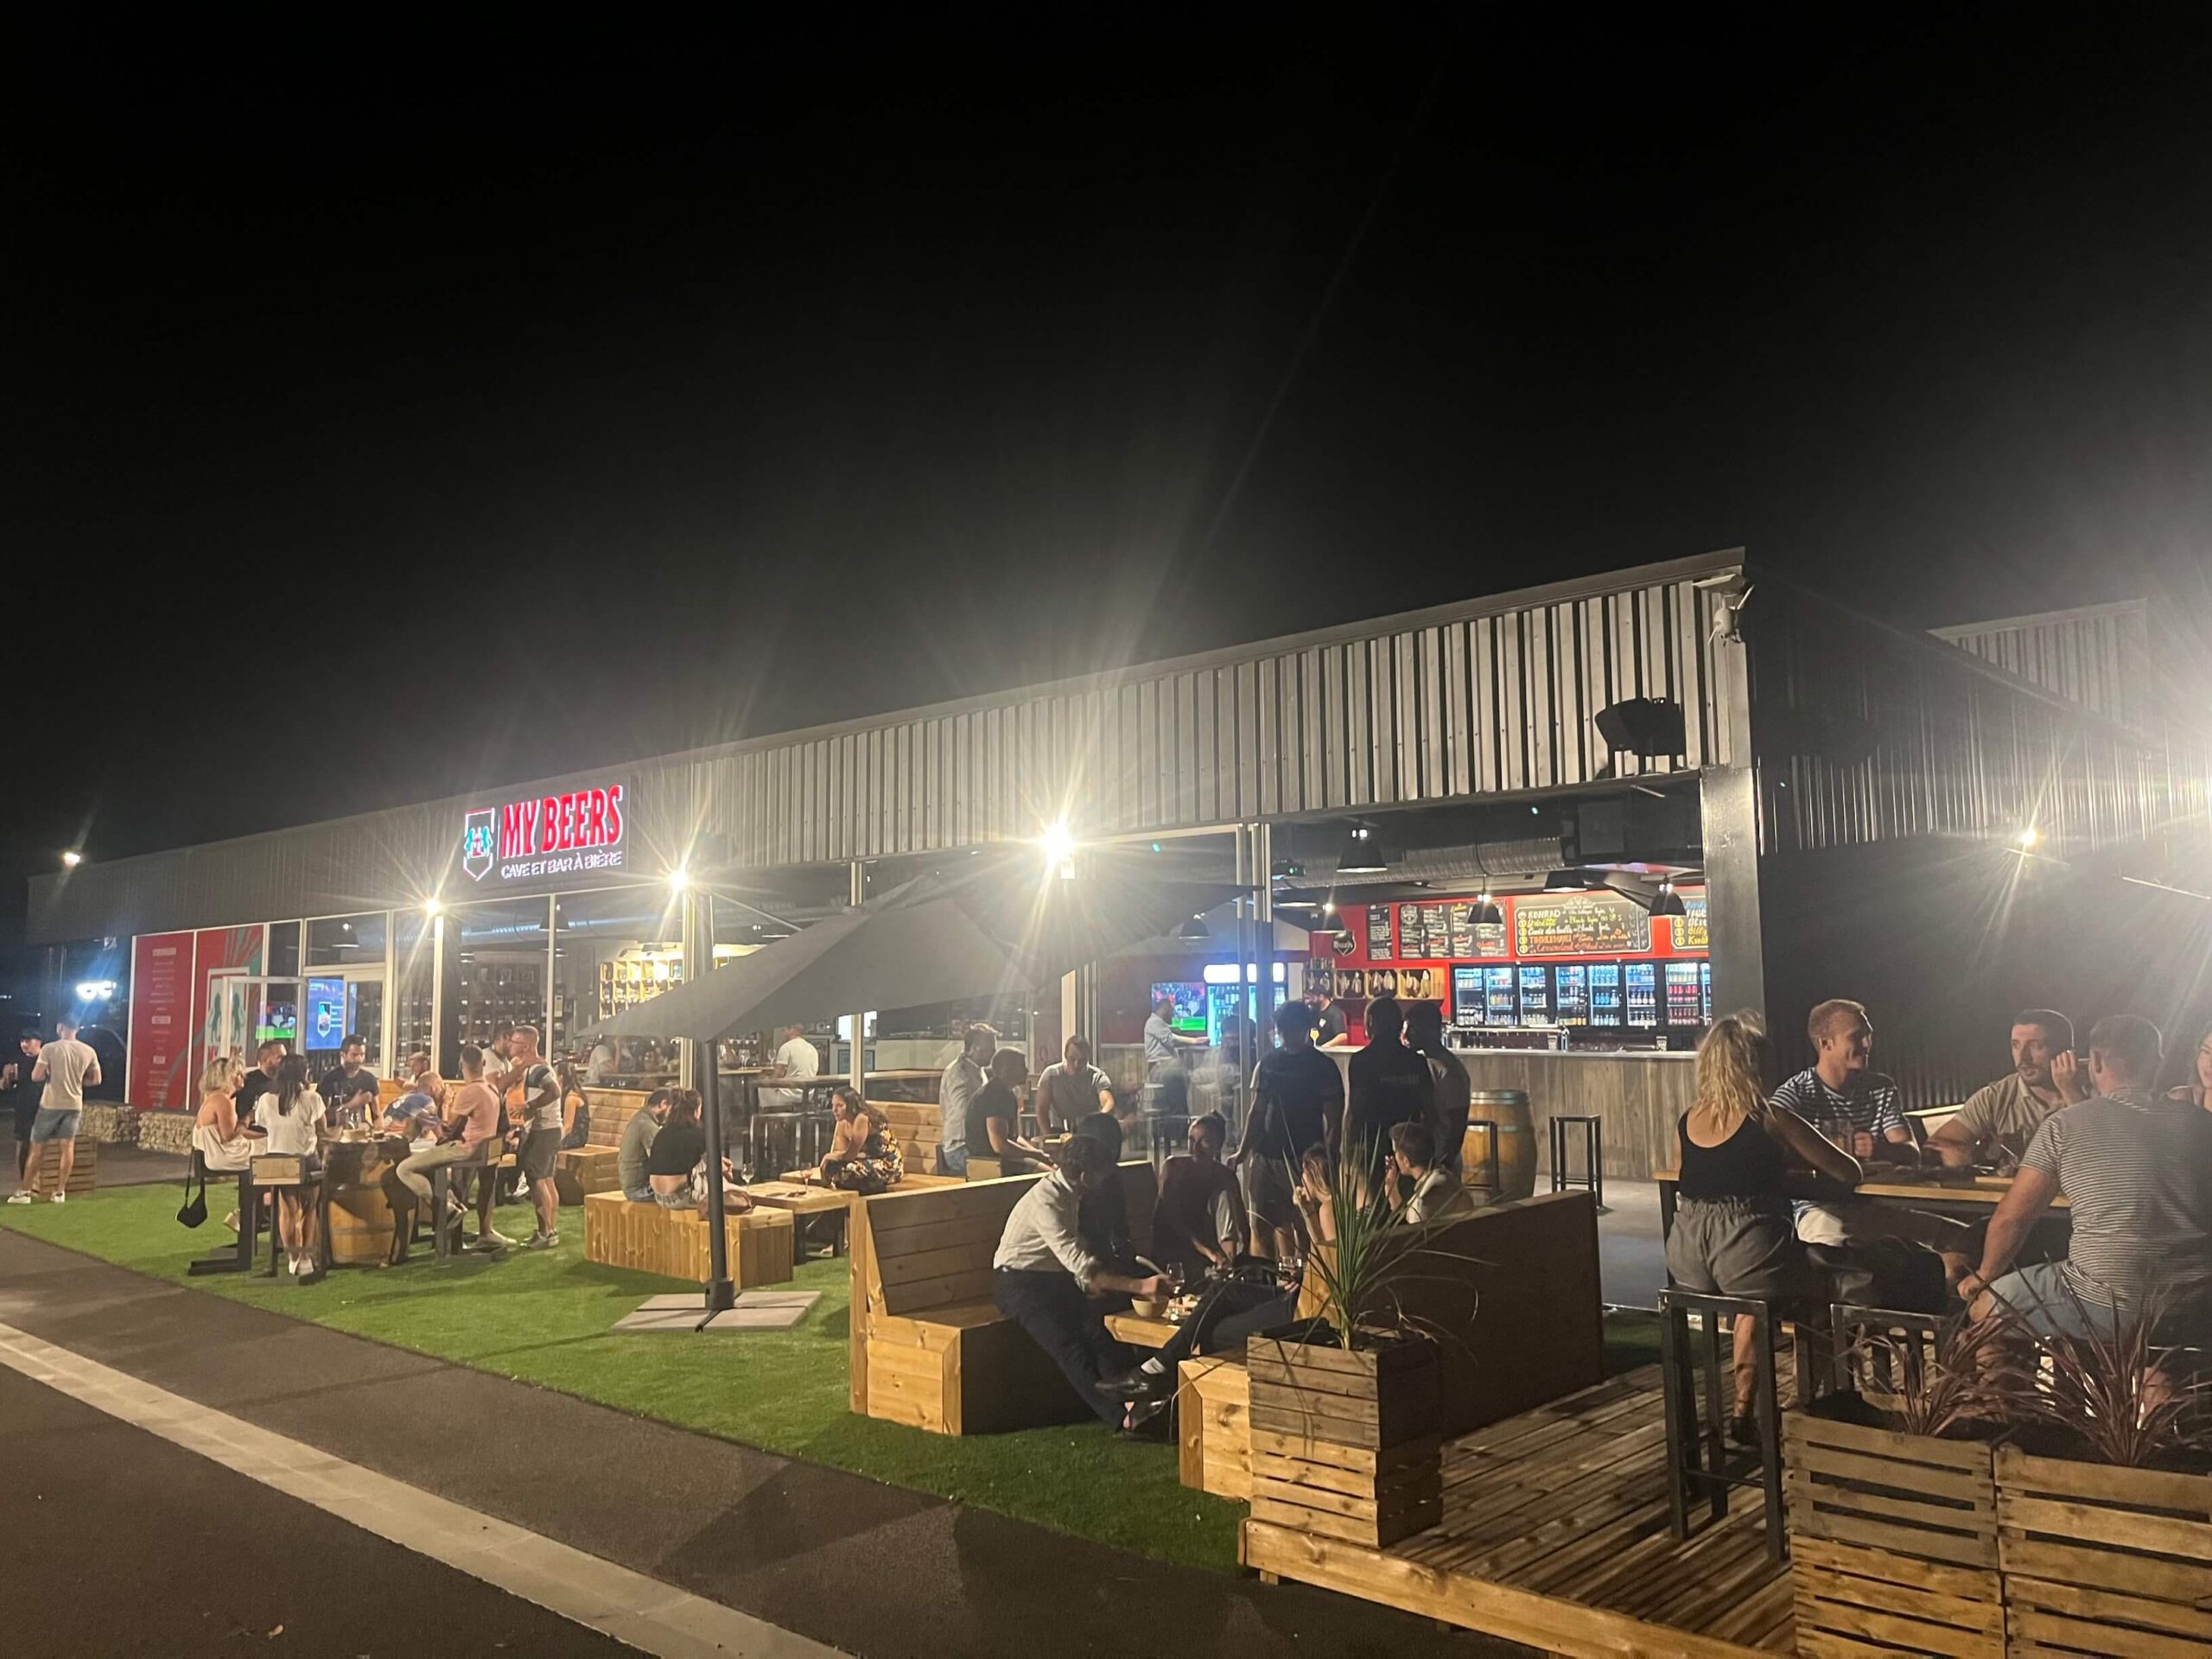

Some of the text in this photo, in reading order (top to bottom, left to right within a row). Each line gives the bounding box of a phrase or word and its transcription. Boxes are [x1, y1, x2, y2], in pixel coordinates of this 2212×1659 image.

[501, 785, 623, 859] MY BEERS
[501, 849, 622, 879] CAVE ET BAR À BIÈRE
